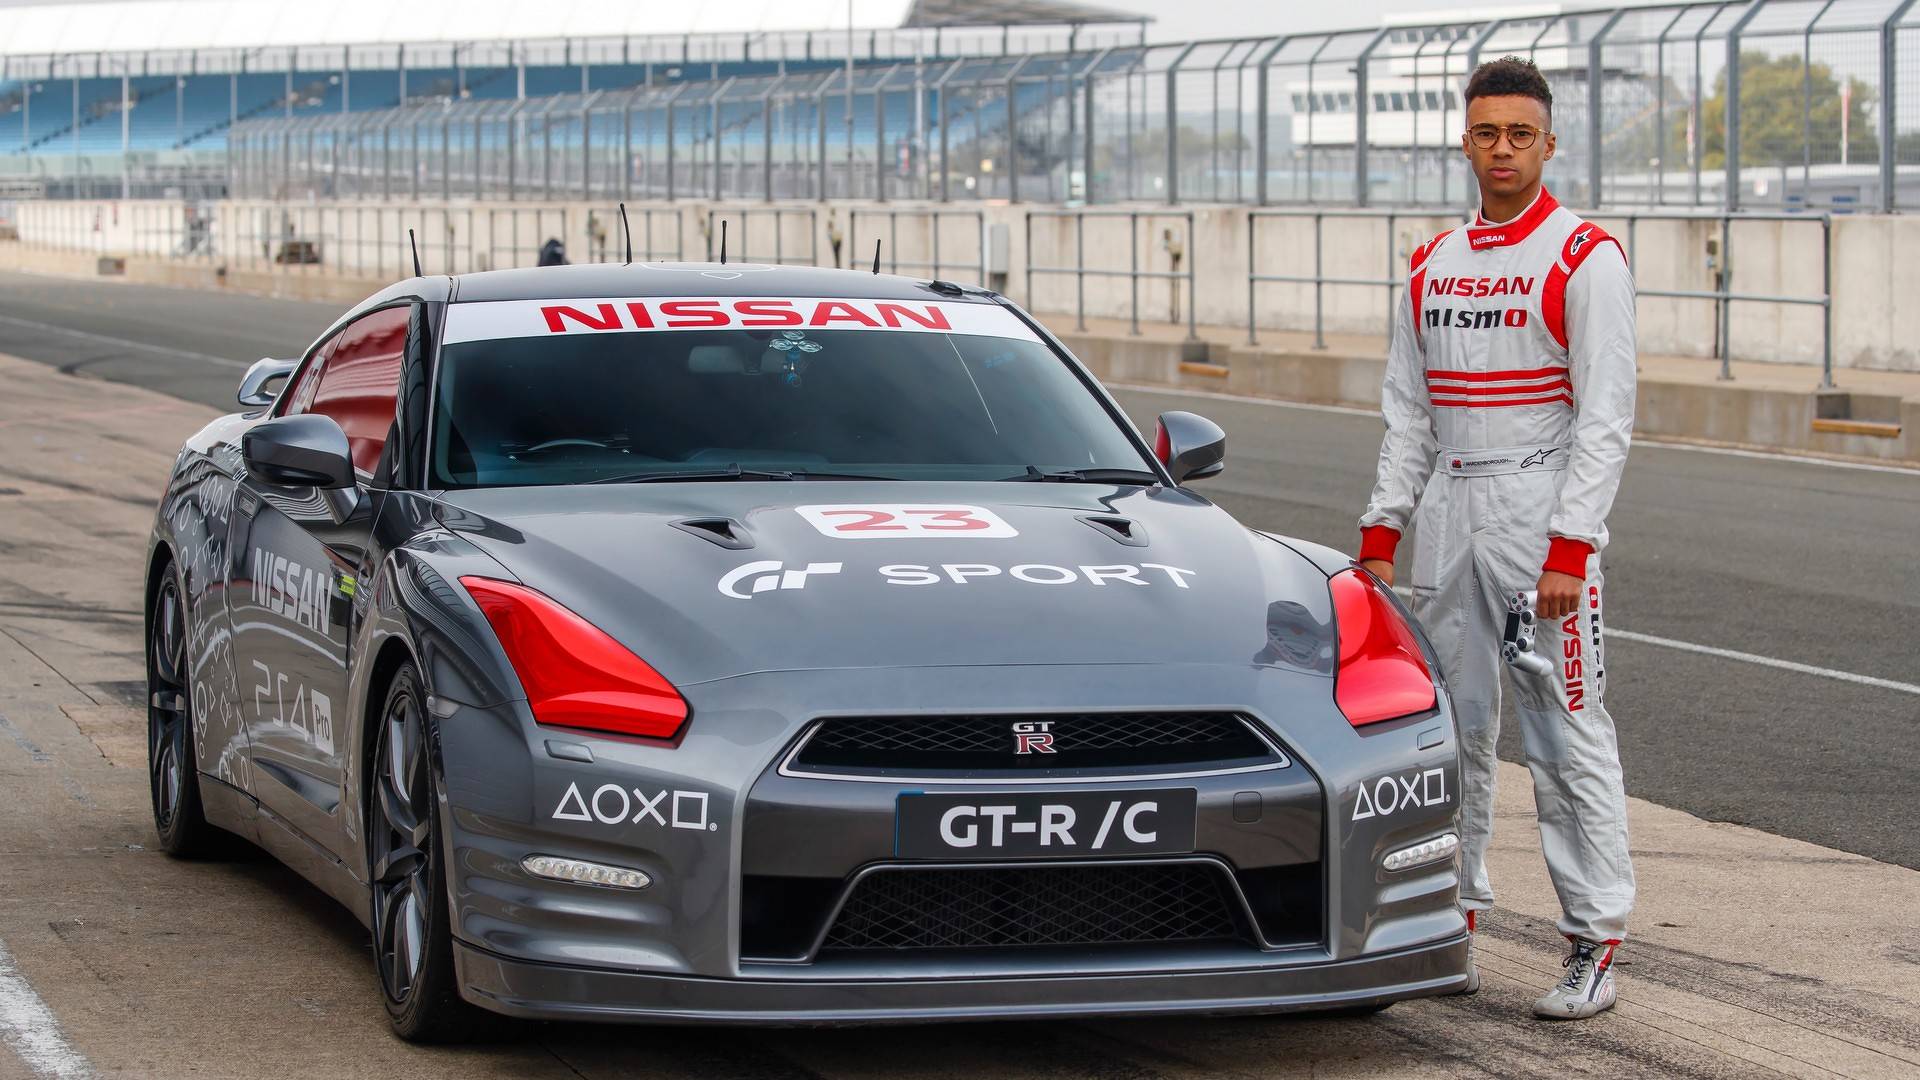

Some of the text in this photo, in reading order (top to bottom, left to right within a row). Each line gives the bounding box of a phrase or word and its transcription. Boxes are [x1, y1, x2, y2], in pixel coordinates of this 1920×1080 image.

[1472, 235, 1505, 246] NISSAN
[1427, 276, 1535, 298] NISSAN
[540, 300, 951, 333] NISSAN
[1424, 307, 1528, 330] nismo
[820, 510, 991, 531] 23
[878, 563, 1197, 589] SPORT
[252, 547, 334, 635] NISSAN
[1562, 612, 1584, 713] NISSA
[314, 703, 330, 741] Pro
[1012, 721, 1056, 733] GT
[1016, 733, 1057, 754] R
[939, 800, 1158, 849] GT-R /C
